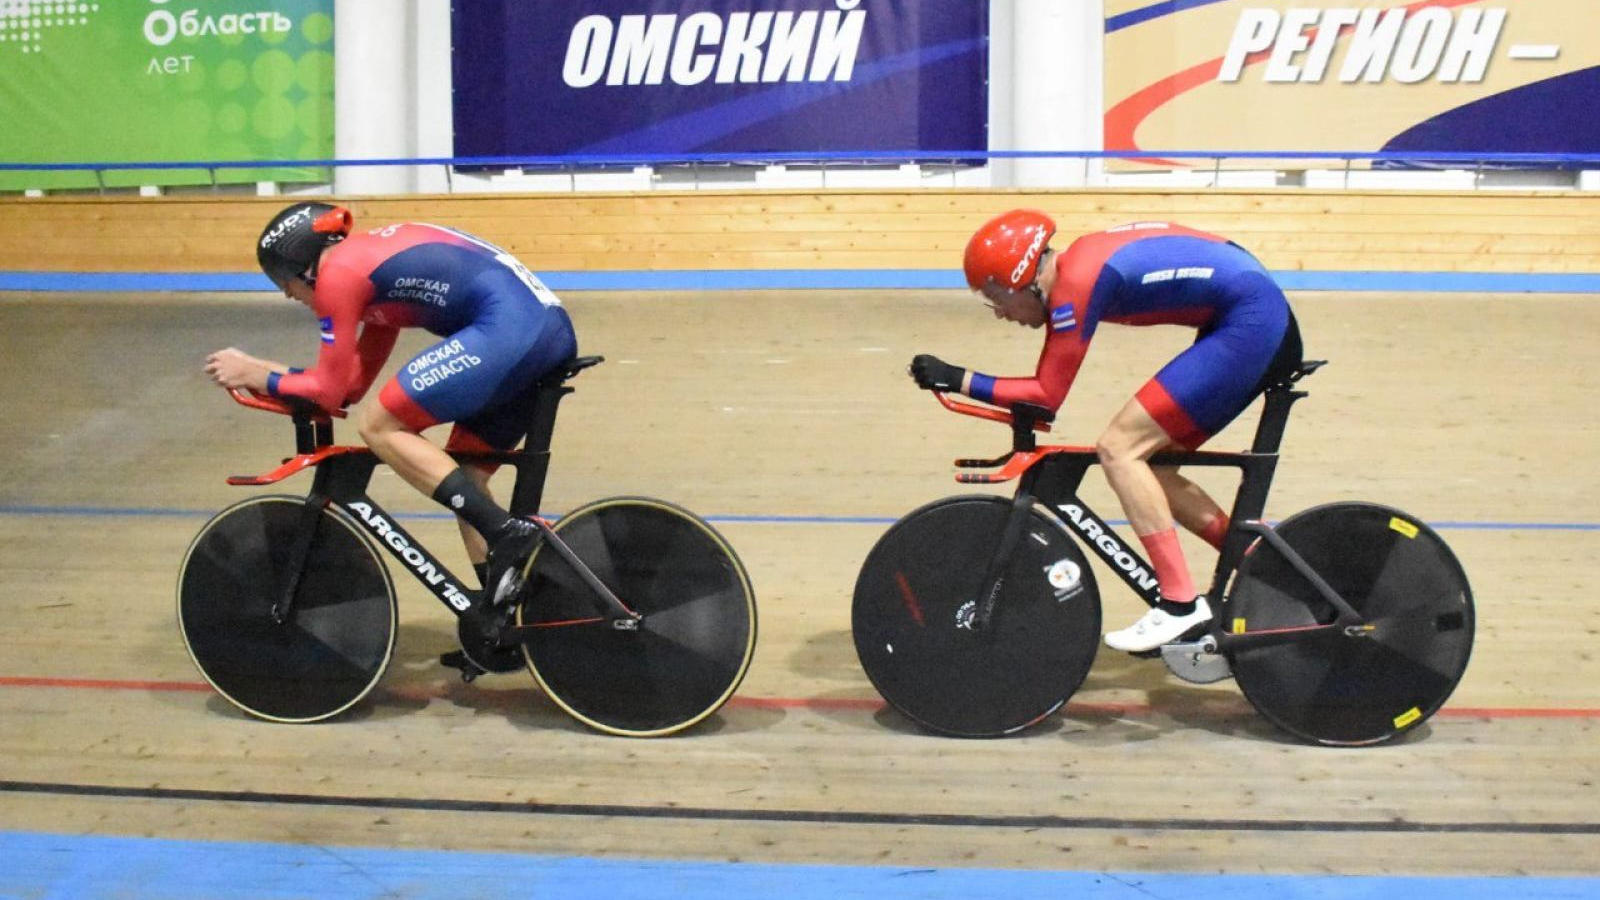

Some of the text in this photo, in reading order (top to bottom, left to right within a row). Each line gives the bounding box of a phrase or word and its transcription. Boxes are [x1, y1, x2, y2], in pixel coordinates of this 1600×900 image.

[143, 9, 292, 46] Область
[562, 0, 866, 88] ОМСКИЙ
[1217, 6, 1507, 83] РЕГИОН
[146, 54, 195, 75] лет
[261, 205, 312, 249] RUDY
[387, 289, 447, 307] ОБЛАСТЬ
[394, 277, 450, 295] ОМСКАЯ
[407, 339, 465, 375] ОМСКАЯ
[411, 354, 482, 392] ОБЛАСТЬ
[346, 502, 472, 611] ARGON 18
[1056, 504, 1158, 591] ARGON
